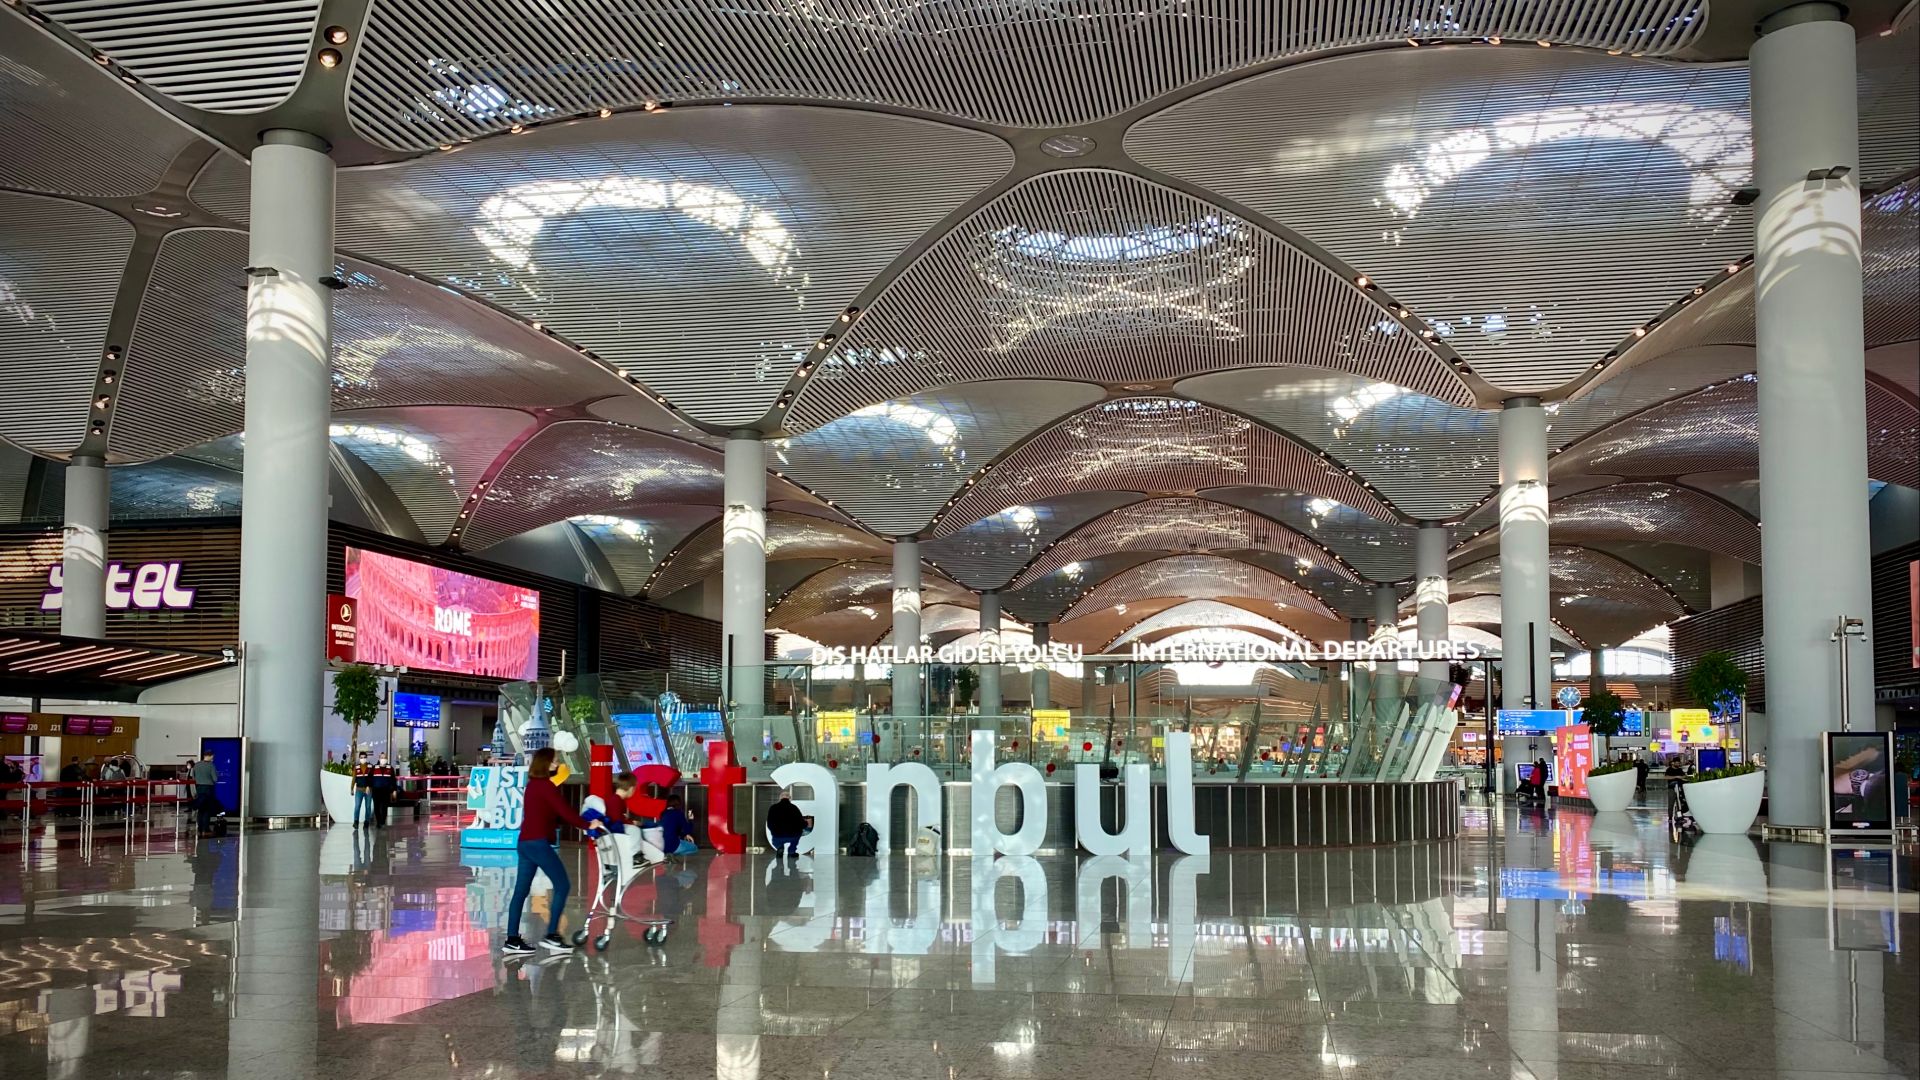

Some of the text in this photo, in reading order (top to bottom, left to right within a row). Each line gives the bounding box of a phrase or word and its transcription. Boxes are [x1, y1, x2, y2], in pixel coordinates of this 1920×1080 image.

[434, 604, 472, 637] ROME
[851, 645, 933, 664] HATLAR
[1011, 643, 1083, 663] YOLCU
[1132, 639, 1480, 662] INTERNATIONAL DEPARTURES
[27, 723, 38, 731] J20
[50, 724, 61, 732] J21
